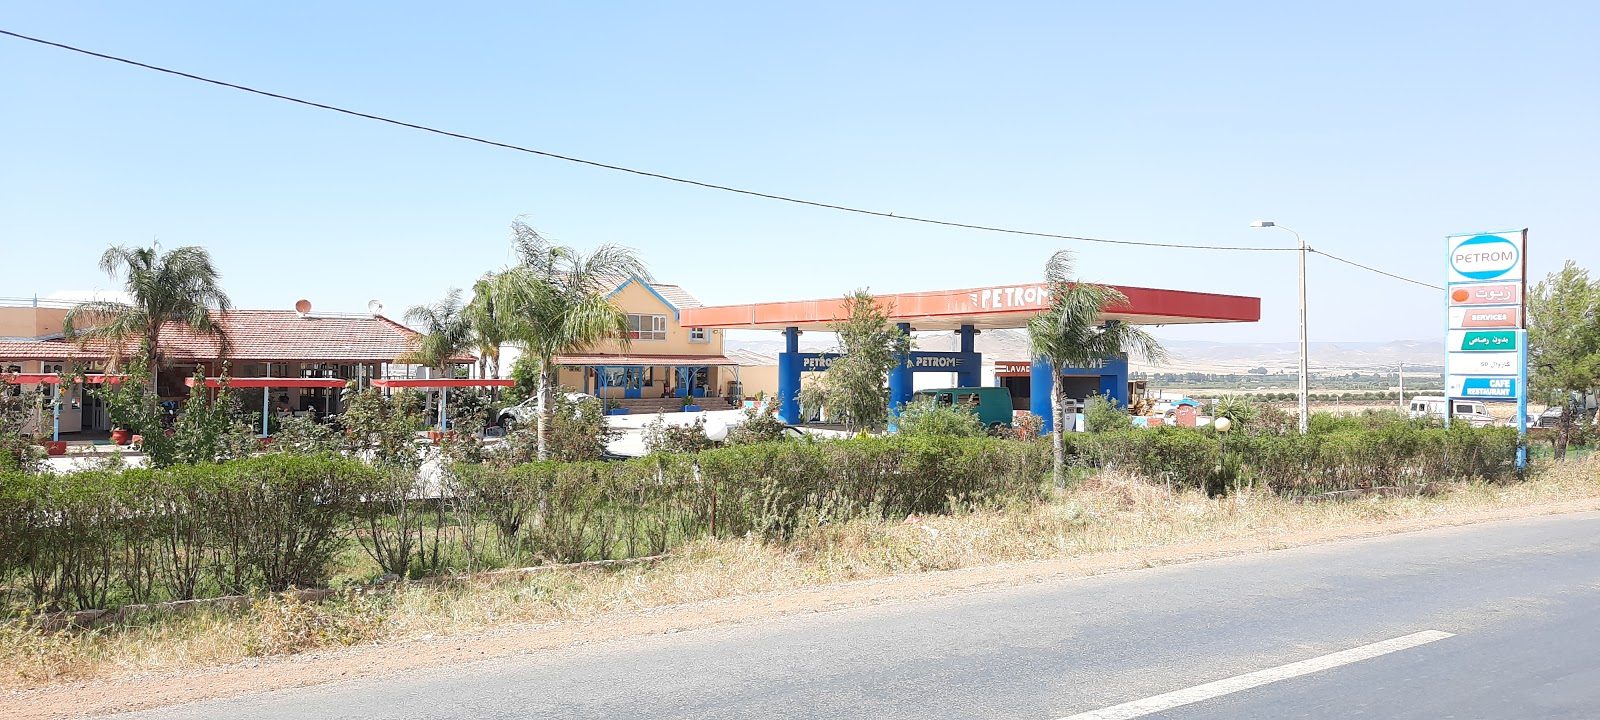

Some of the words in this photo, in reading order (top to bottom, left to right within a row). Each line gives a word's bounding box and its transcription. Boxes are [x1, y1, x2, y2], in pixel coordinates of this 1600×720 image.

[1456, 251, 1513, 263] PETROM
[1472, 313, 1507, 321] SERVICES
[803, 357, 832, 367] PETRO
[916, 357, 956, 367] PETROM
[1489, 379, 1511, 388] CAFE
[1466, 387, 1511, 396] RESTAURANT
